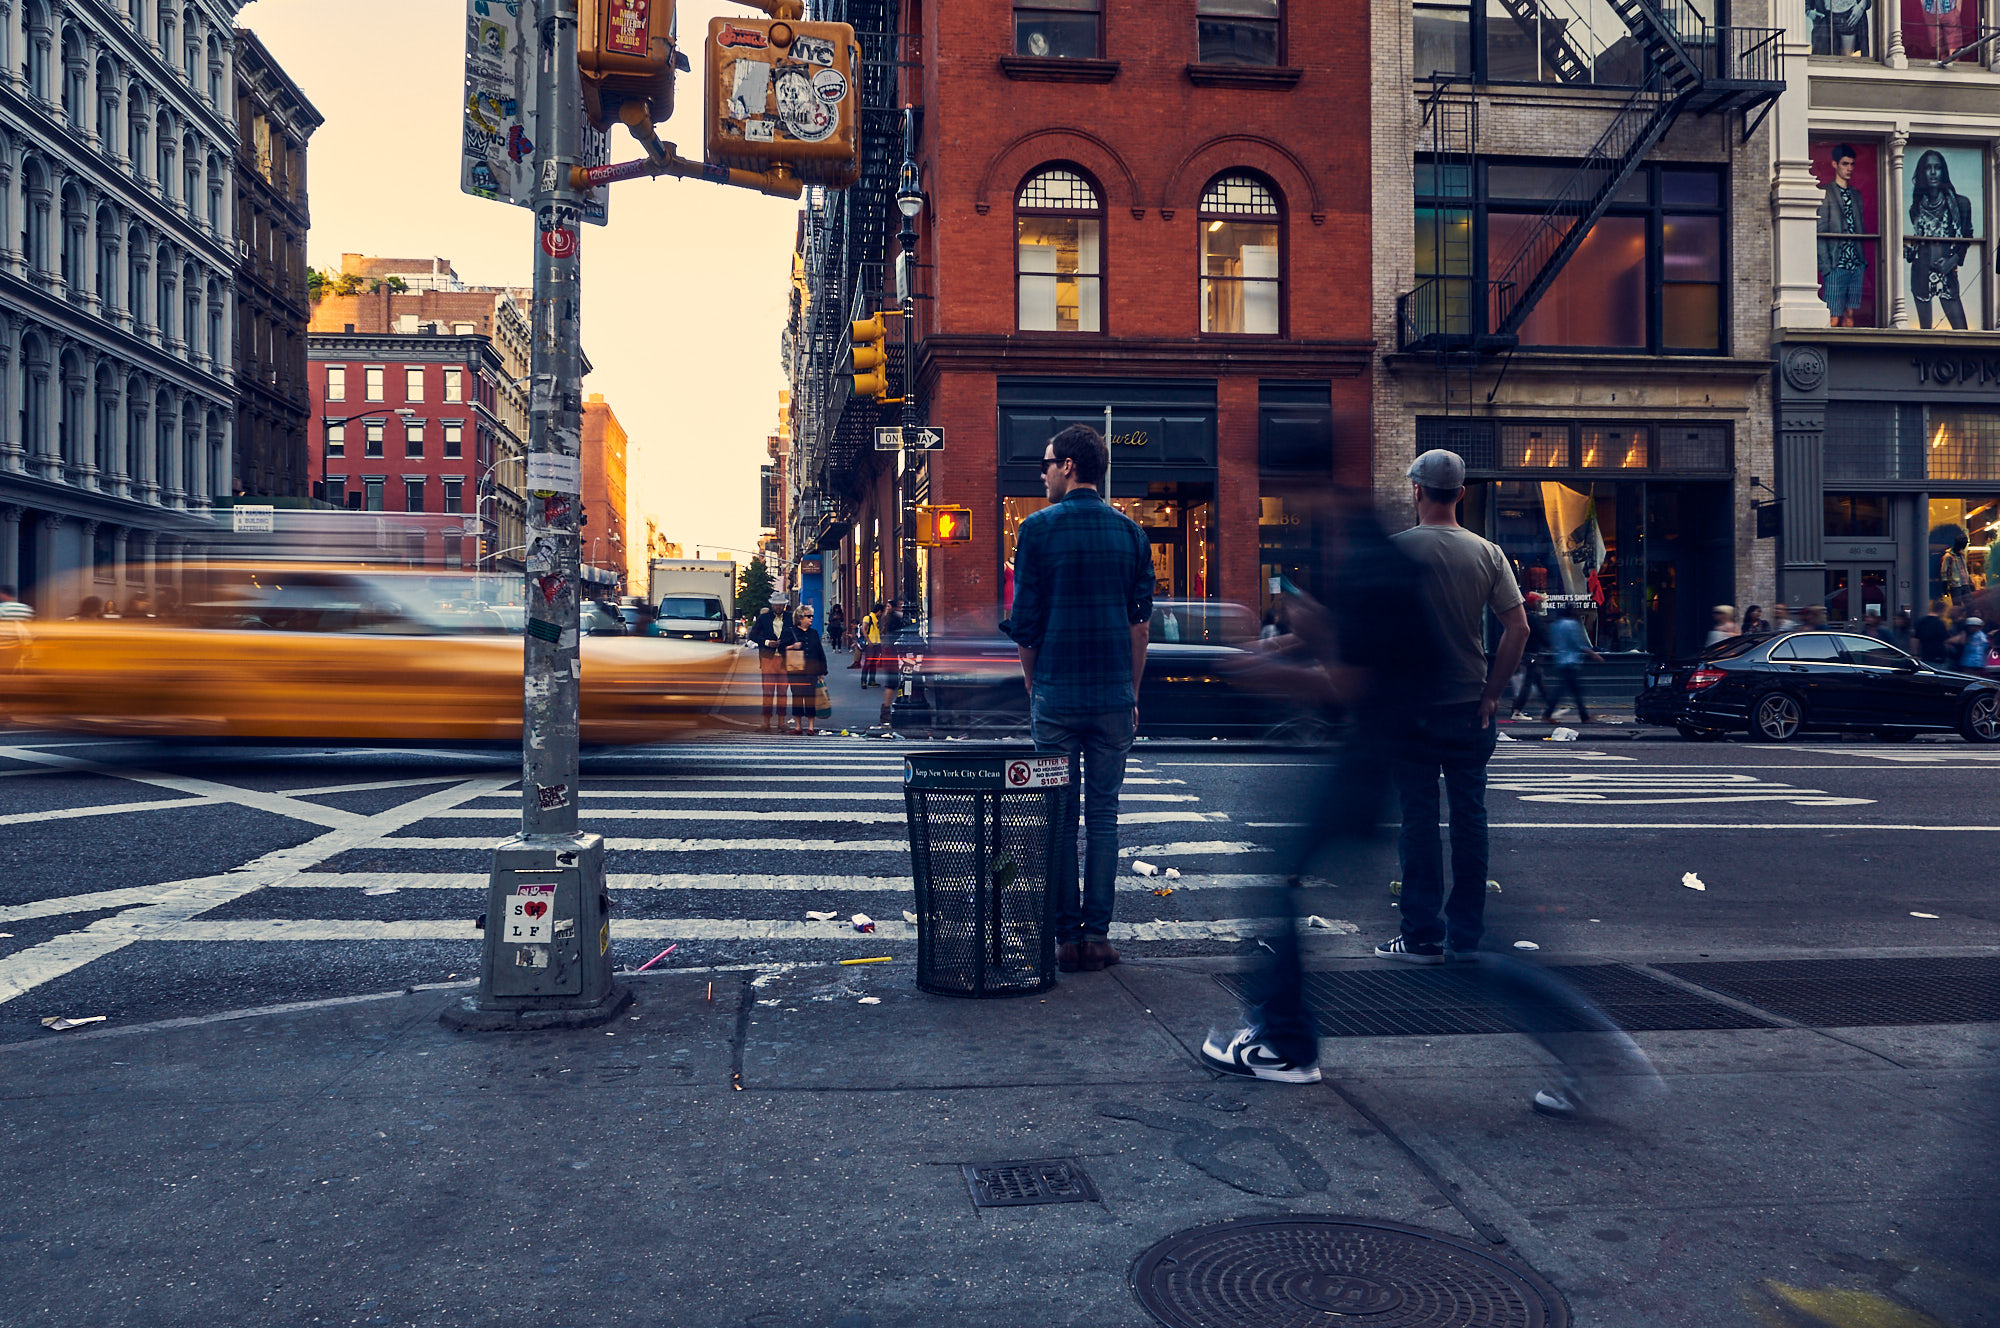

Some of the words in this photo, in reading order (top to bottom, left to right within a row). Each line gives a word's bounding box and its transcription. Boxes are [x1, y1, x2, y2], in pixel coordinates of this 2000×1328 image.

[789, 42, 834, 64] NYC
[1037, 758, 1059, 767] LITTER
[915, 768, 928, 778] Keep
[929, 769, 940, 777] New
[943, 769, 960, 777] York
[961, 769, 976, 779] City
[979, 769, 1000, 778] Clean
